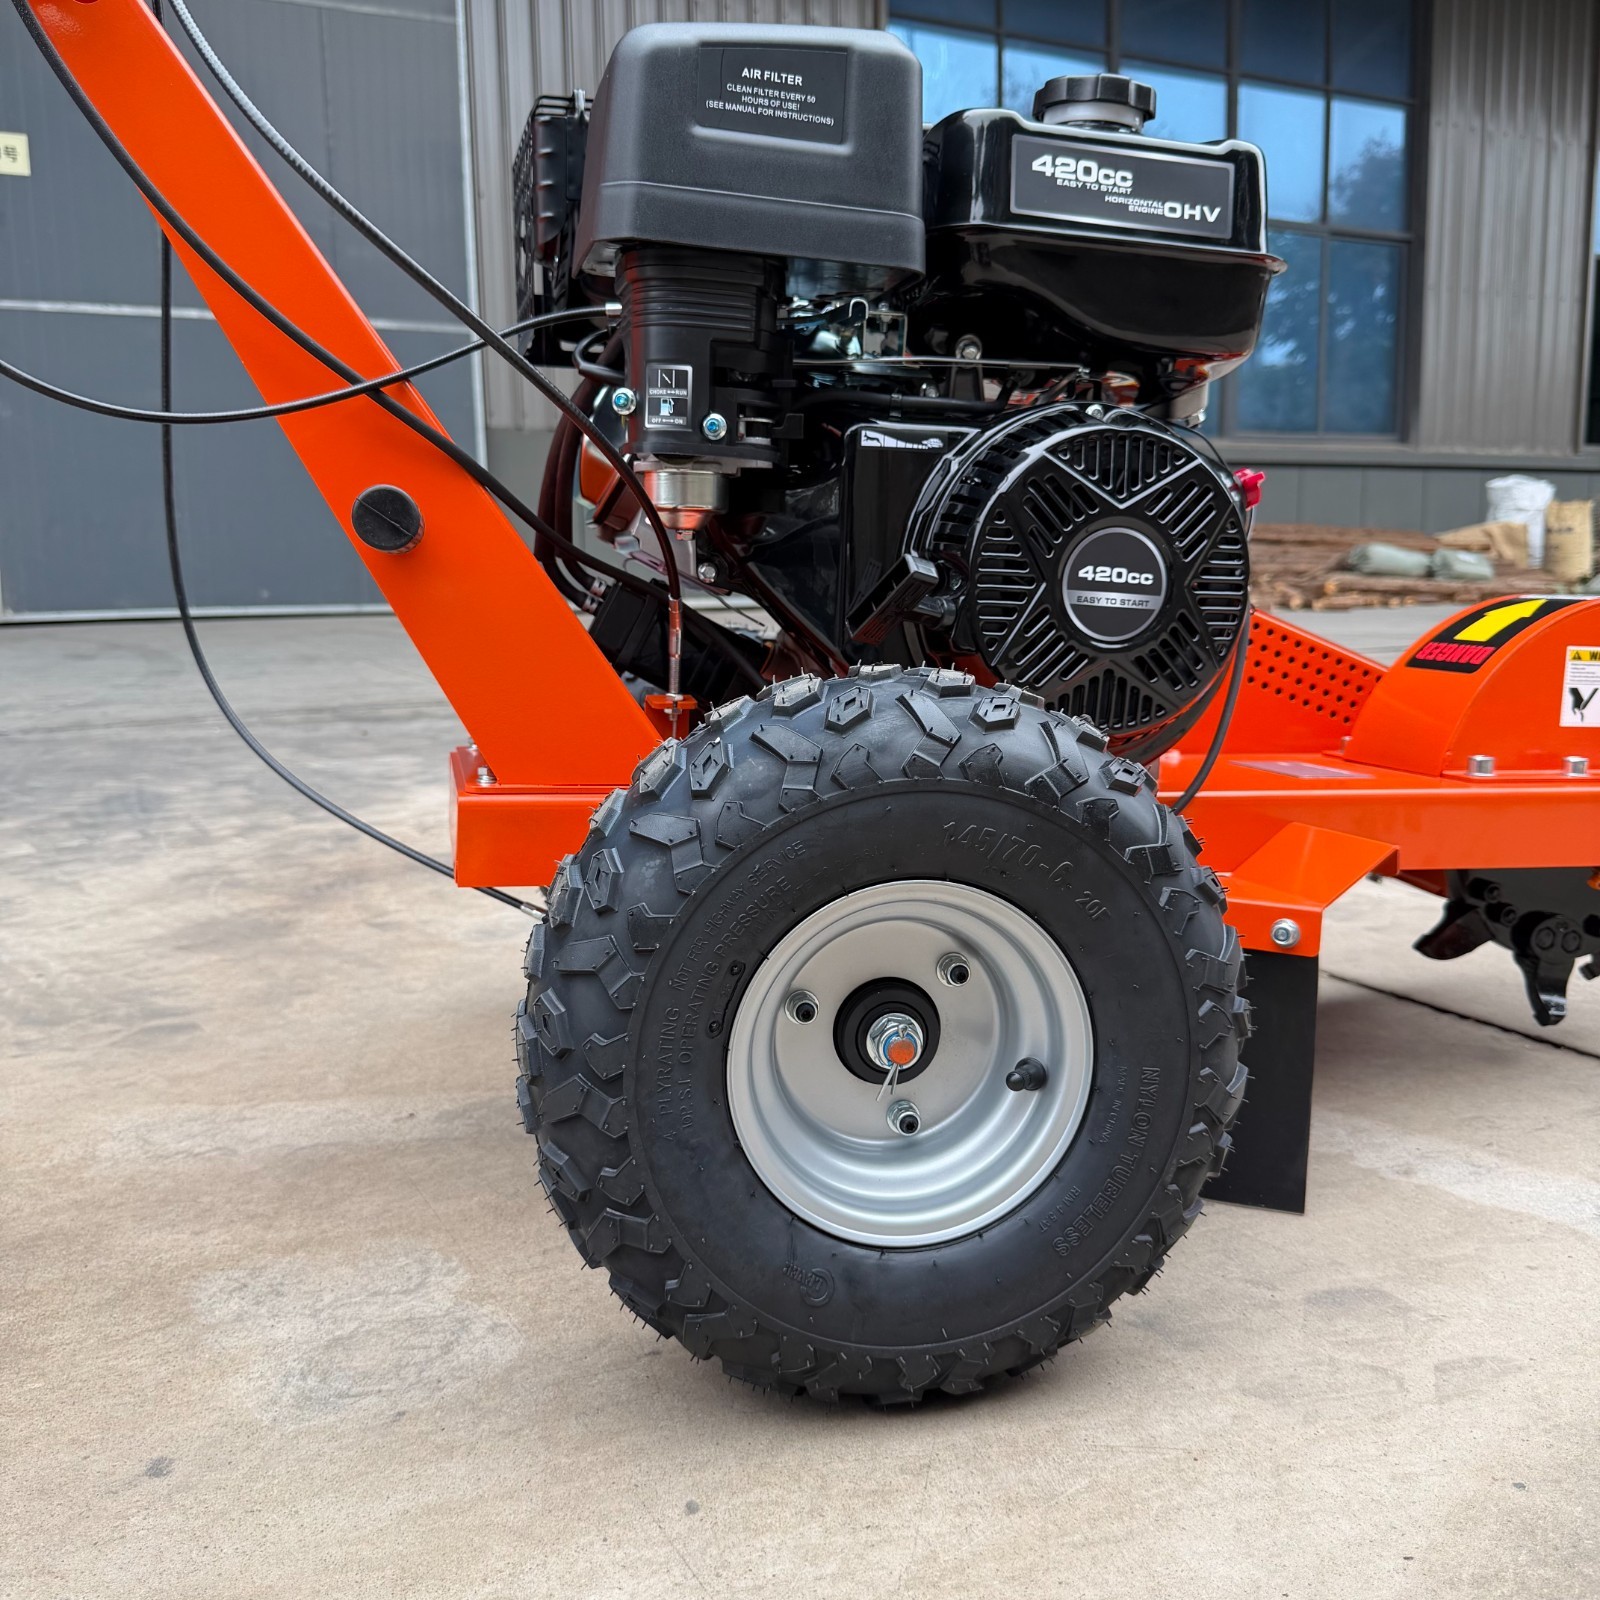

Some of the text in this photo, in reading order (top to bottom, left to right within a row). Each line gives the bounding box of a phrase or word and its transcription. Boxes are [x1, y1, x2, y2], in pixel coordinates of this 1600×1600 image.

[742, 67, 803, 86] AIR FILTER
[726, 83, 816, 104] CLEAN FILTER EVERY 50
[742, 96, 800, 110] HOURS OF USE!
[705, 100, 835, 127] (SEE MANUAL FOR INSTRUCTIONS)
[1031, 154, 1134, 187] 420cc
[1056, 178, 1133, 195] EASY TO START
[1104, 195, 1163, 208] HORIZONTAL
[1128, 201, 1221, 223] ENGINE OHV
[1077, 565, 1154, 586] 420cc
[1076, 595, 1150, 608] EASY TO START
[1415, 641, 1496, 665] DANGER
[674, 963, 693, 991] NOT
[687, 936, 709, 962] FOR
[748, 840, 806, 887] SERVICE
[677, 961, 719, 1064] OPERATING
[713, 874, 792, 958] PRESSURE
[1052, 1066, 1161, 1256] NYLON TUBELESS
